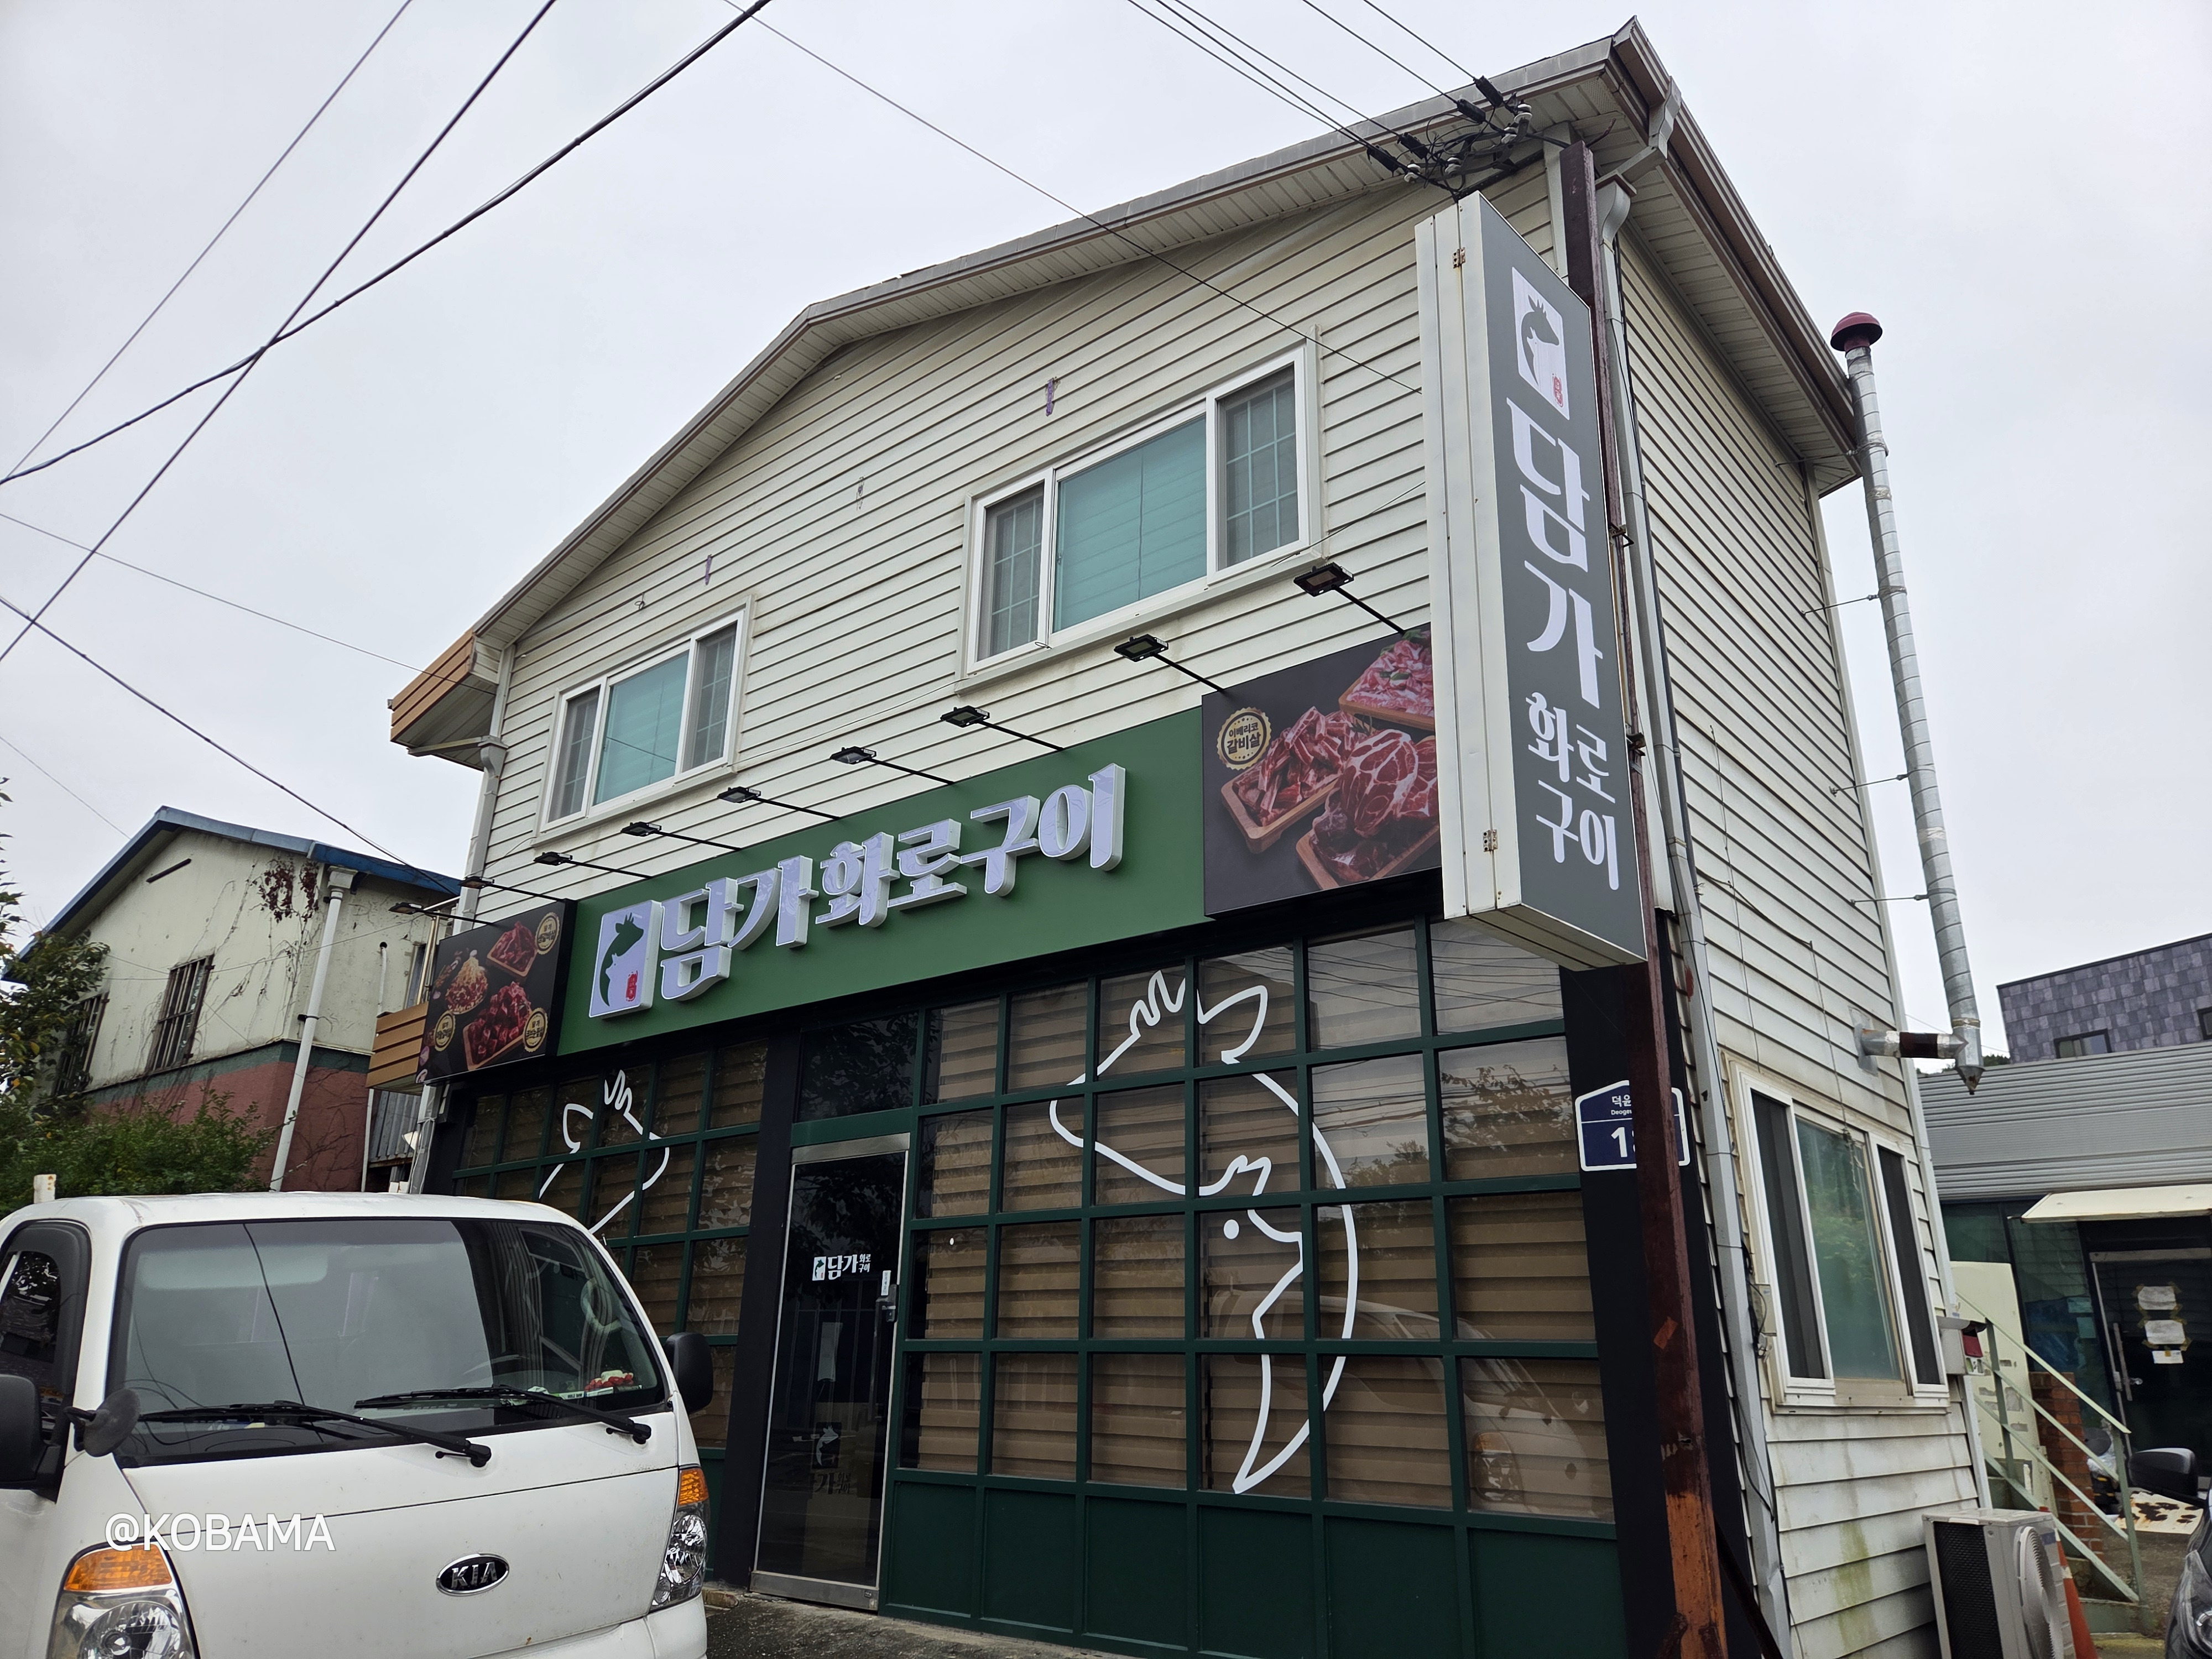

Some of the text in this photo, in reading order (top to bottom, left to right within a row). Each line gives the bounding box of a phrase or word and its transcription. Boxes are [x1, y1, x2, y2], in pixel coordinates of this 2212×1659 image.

[1506, 398, 1603, 708] 담가
[1227, 732, 1261, 754] 갈비살
[1229, 722, 1259, 737] 이베리코
[1526, 692, 1615, 804] 화로
[1536, 780, 1619, 890] 구이
[1611, 1127, 1635, 1158] 1
[827, 1254, 858, 1280] 담가
[858, 1263, 870, 1272] 구이
[450, 1561, 498, 1589] KIA
